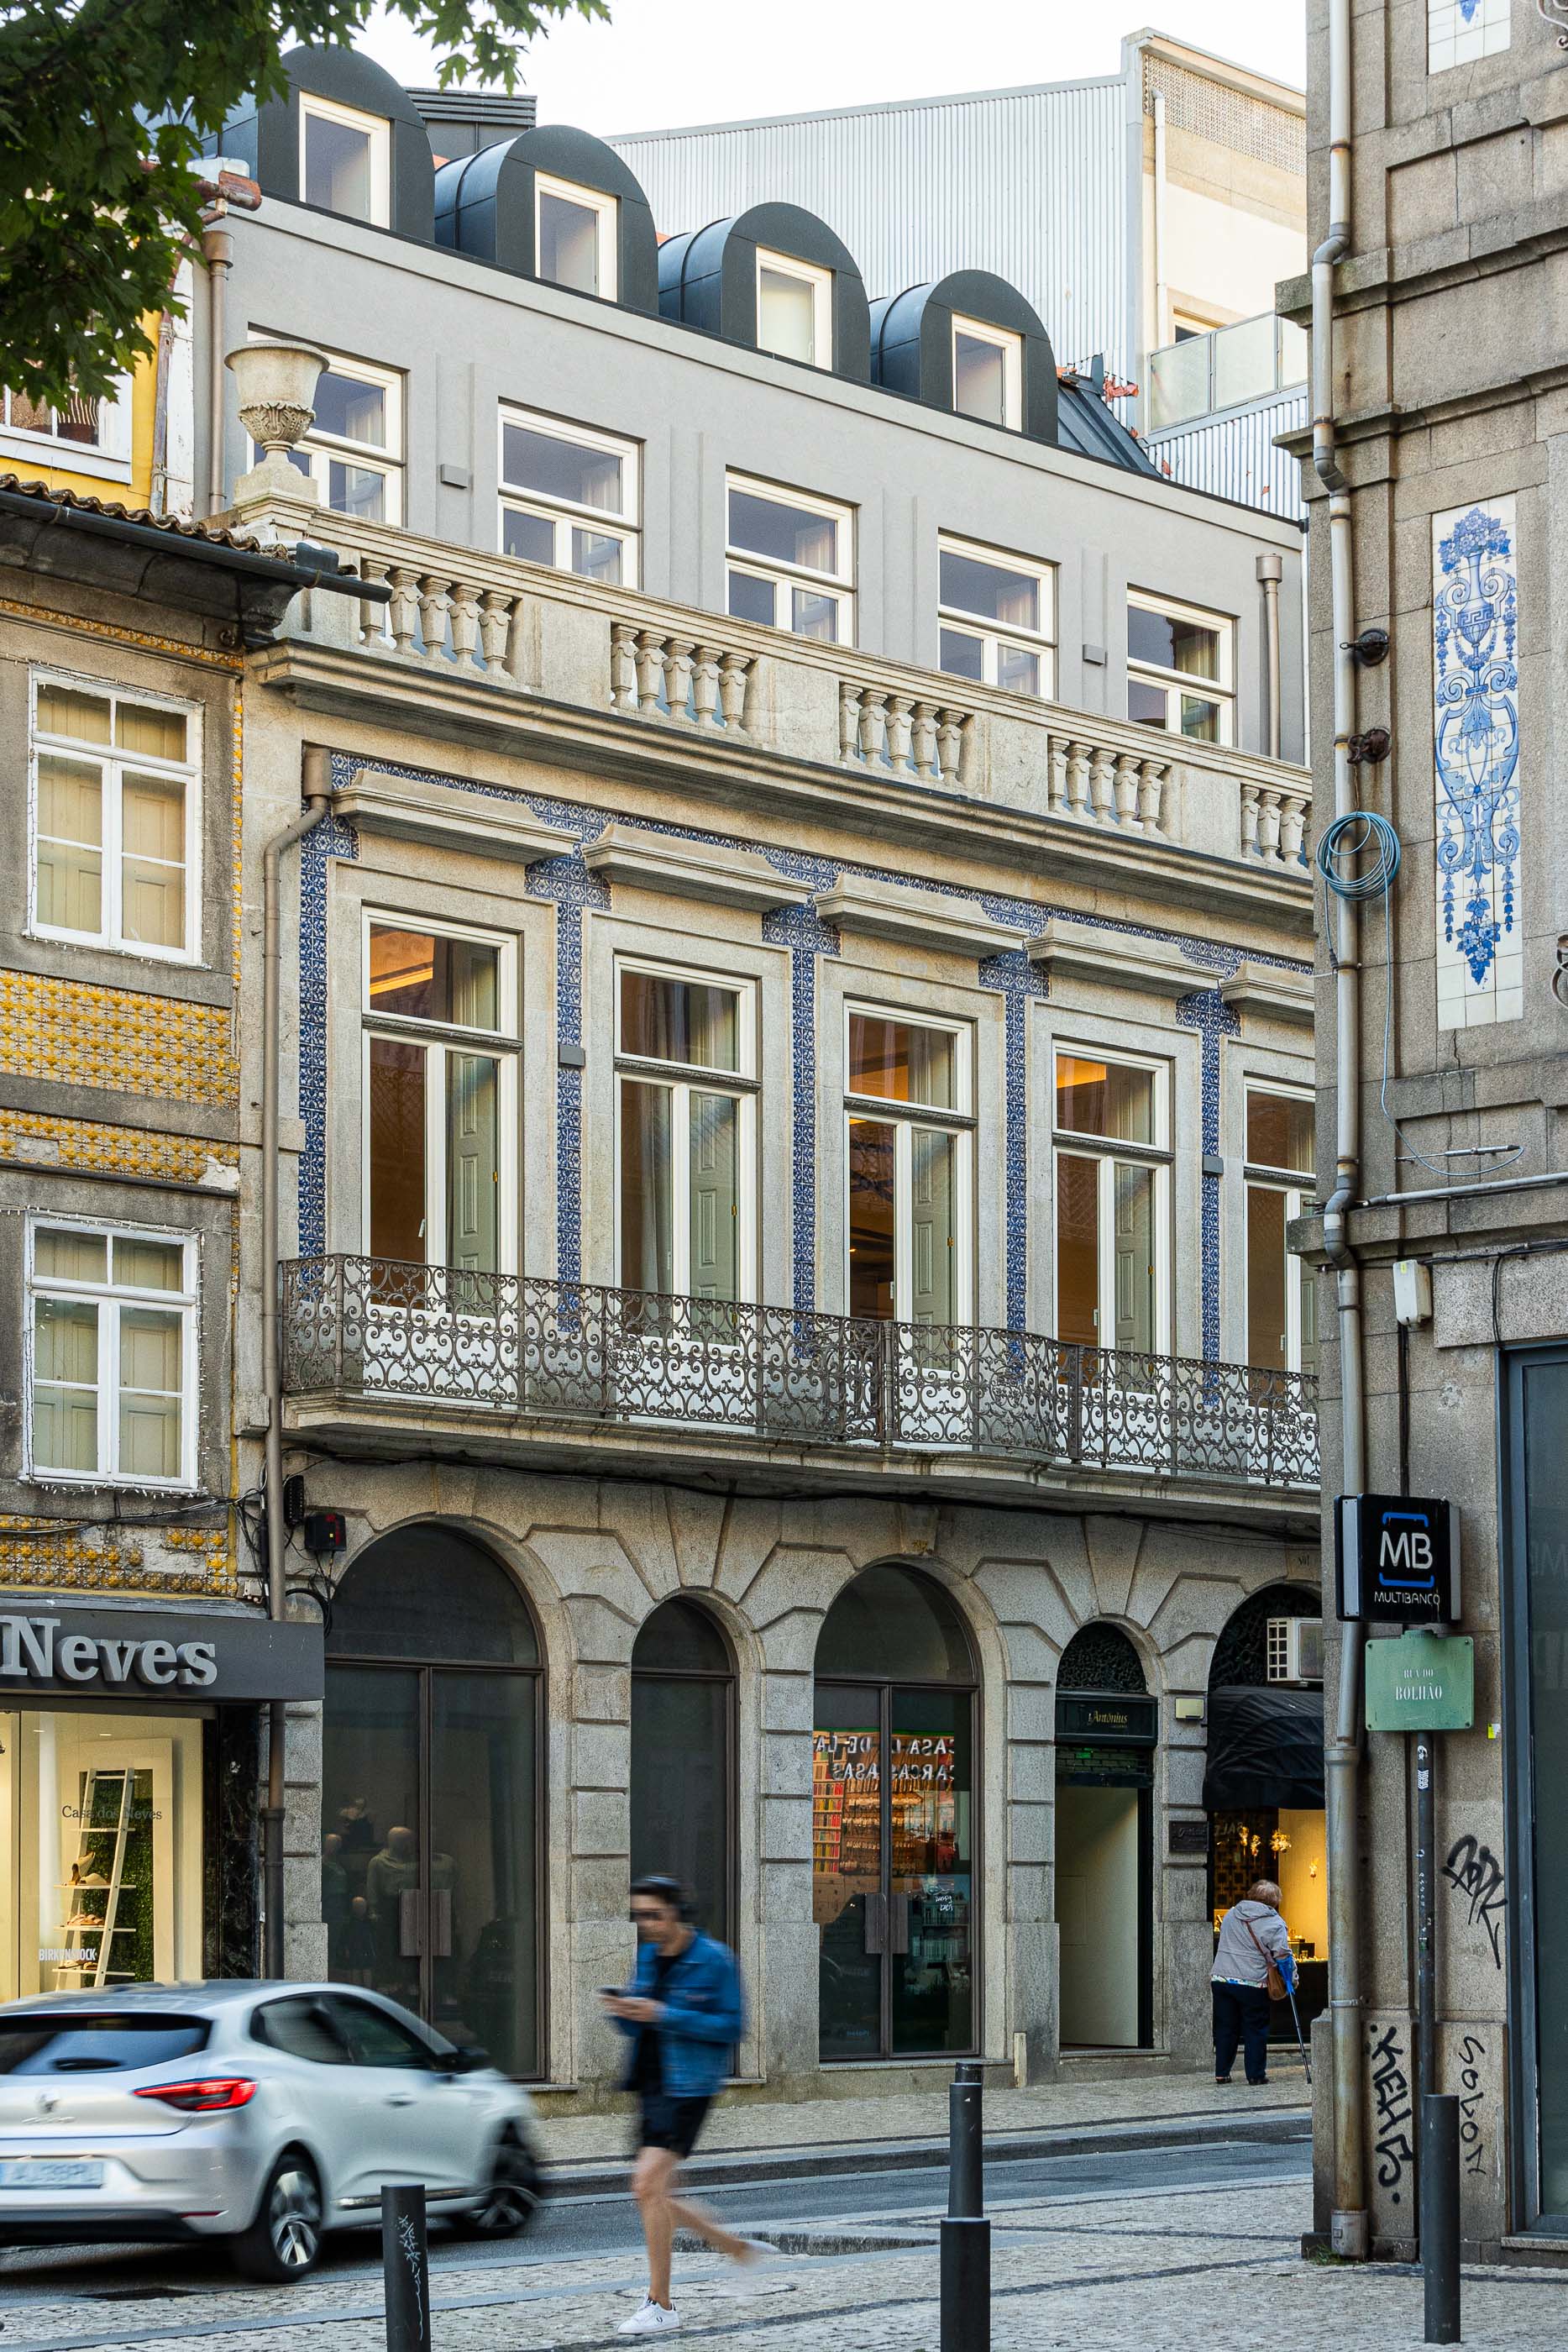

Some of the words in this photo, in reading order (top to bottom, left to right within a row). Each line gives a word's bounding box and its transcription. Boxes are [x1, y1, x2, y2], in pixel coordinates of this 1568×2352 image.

[1380, 1530, 1433, 1569] MB
[1374, 1591, 1440, 1605] MULTIBANCO
[0, 1614, 218, 1686] Neves
[1403, 1668, 1419, 1679] RUA
[1423, 1668, 1434, 1678] DO
[1396, 1683, 1443, 1701] BOLHÃO
[39, 1948, 97, 1961] BIRKNOCK
